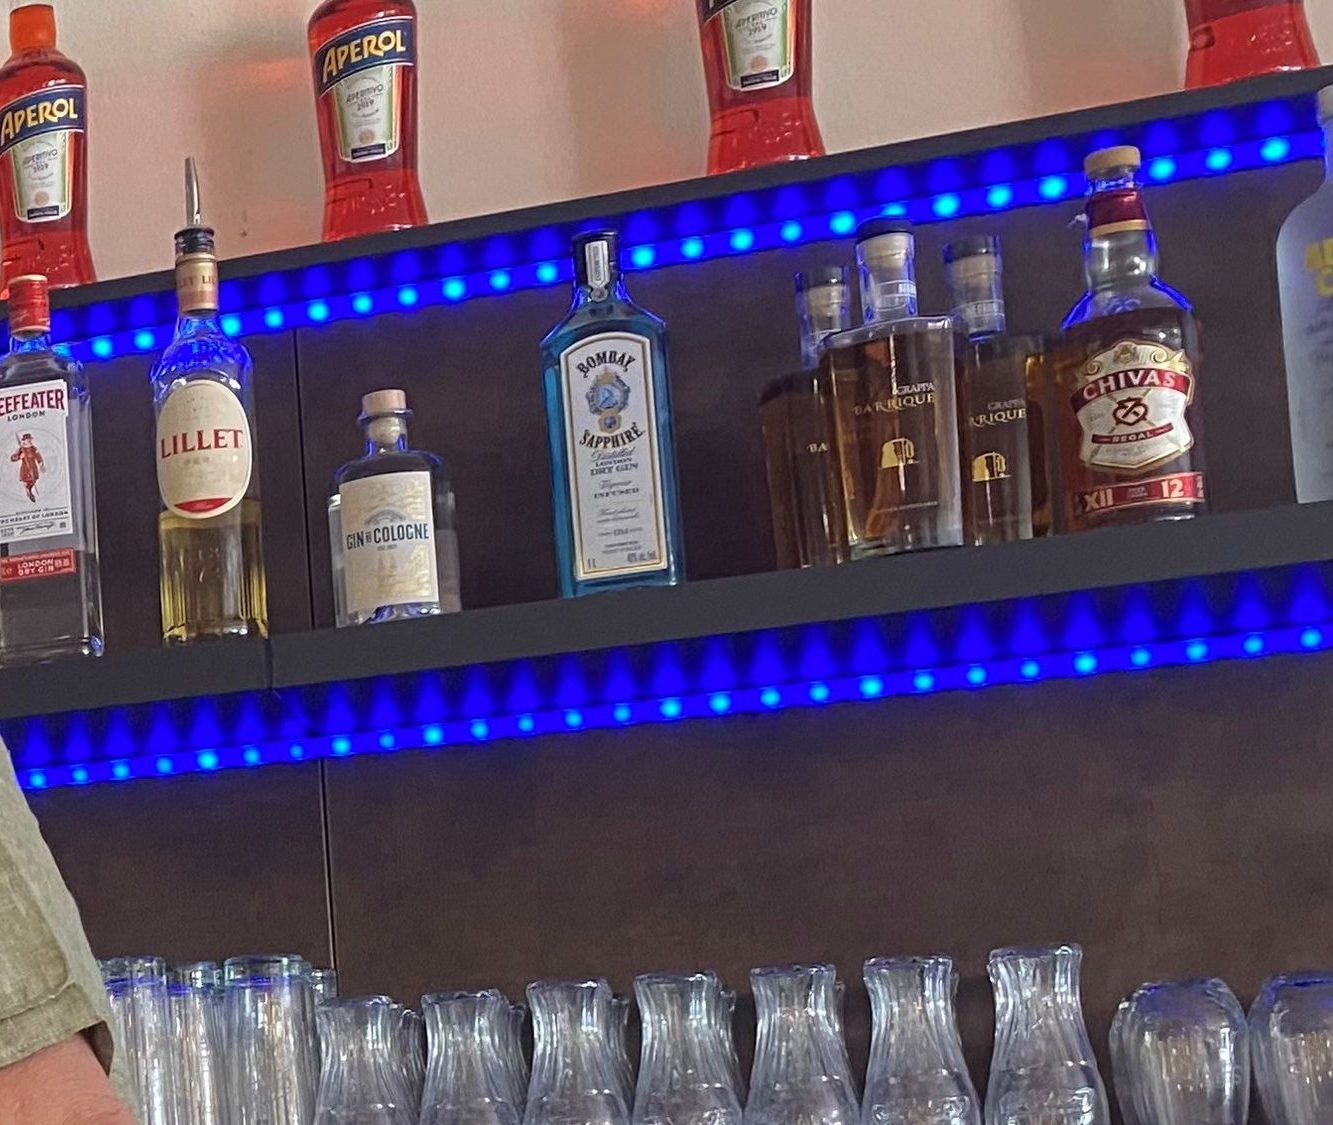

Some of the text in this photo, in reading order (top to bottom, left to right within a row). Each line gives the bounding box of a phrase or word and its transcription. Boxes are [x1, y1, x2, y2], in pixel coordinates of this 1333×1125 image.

[323, 30, 406, 82] APEROL
[0, 98, 78, 146] APEROL
[575, 350, 636, 378] BOMBAY
[1083, 369, 1176, 400] CHIVAS
[7, 410, 46, 422] LONDON
[854, 394, 935, 416] BARRIQUE
[160, 428, 243, 460] LILLET
[579, 422, 645, 449] SAPPHIRE
[807, 442, 828, 453] BA
[1111, 432, 1153, 443] REGAL
[1161, 478, 1184, 498] 12
[346, 530, 365, 550] GIN
[373, 523, 430, 544] COLOGNE
